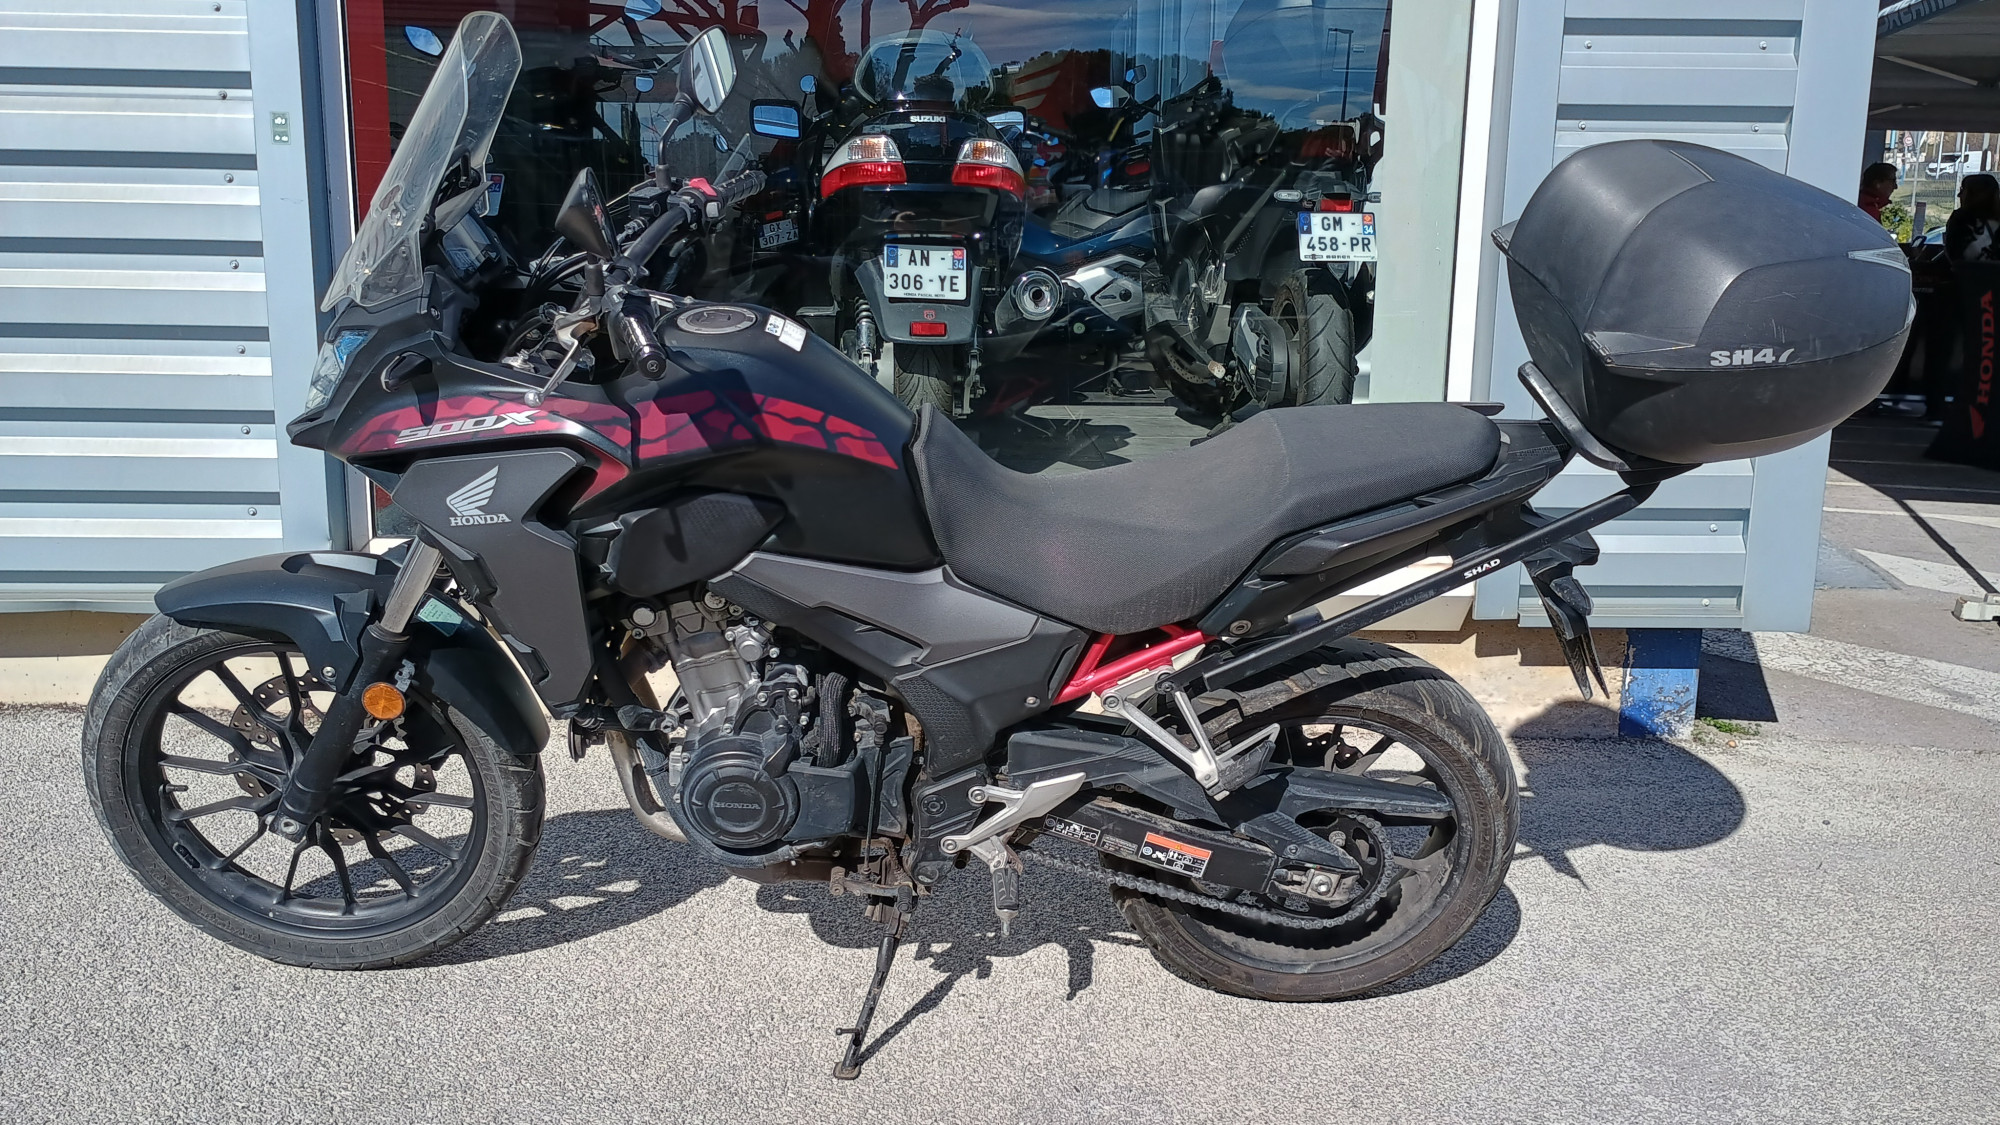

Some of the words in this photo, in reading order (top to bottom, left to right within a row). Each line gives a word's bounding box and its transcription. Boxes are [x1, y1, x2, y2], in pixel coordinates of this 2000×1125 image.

[770, 223, 781, 232] GX
[1321, 216, 1342, 232] GM
[1364, 225, 1374, 234] 34
[762, 232, 798, 246] 307-ZA
[1306, 236, 1372, 252] 458-PR
[908, 250, 930, 266] AN
[954, 260, 964, 270] 34
[889, 273, 960, 292] 306-YE
[1977, 290, 1994, 404] HONDA
[395, 410, 542, 443] 500X
[449, 514, 512, 526] HONDA
[1464, 558, 1500, 579] SHAD
[714, 801, 761, 810] HONDA
